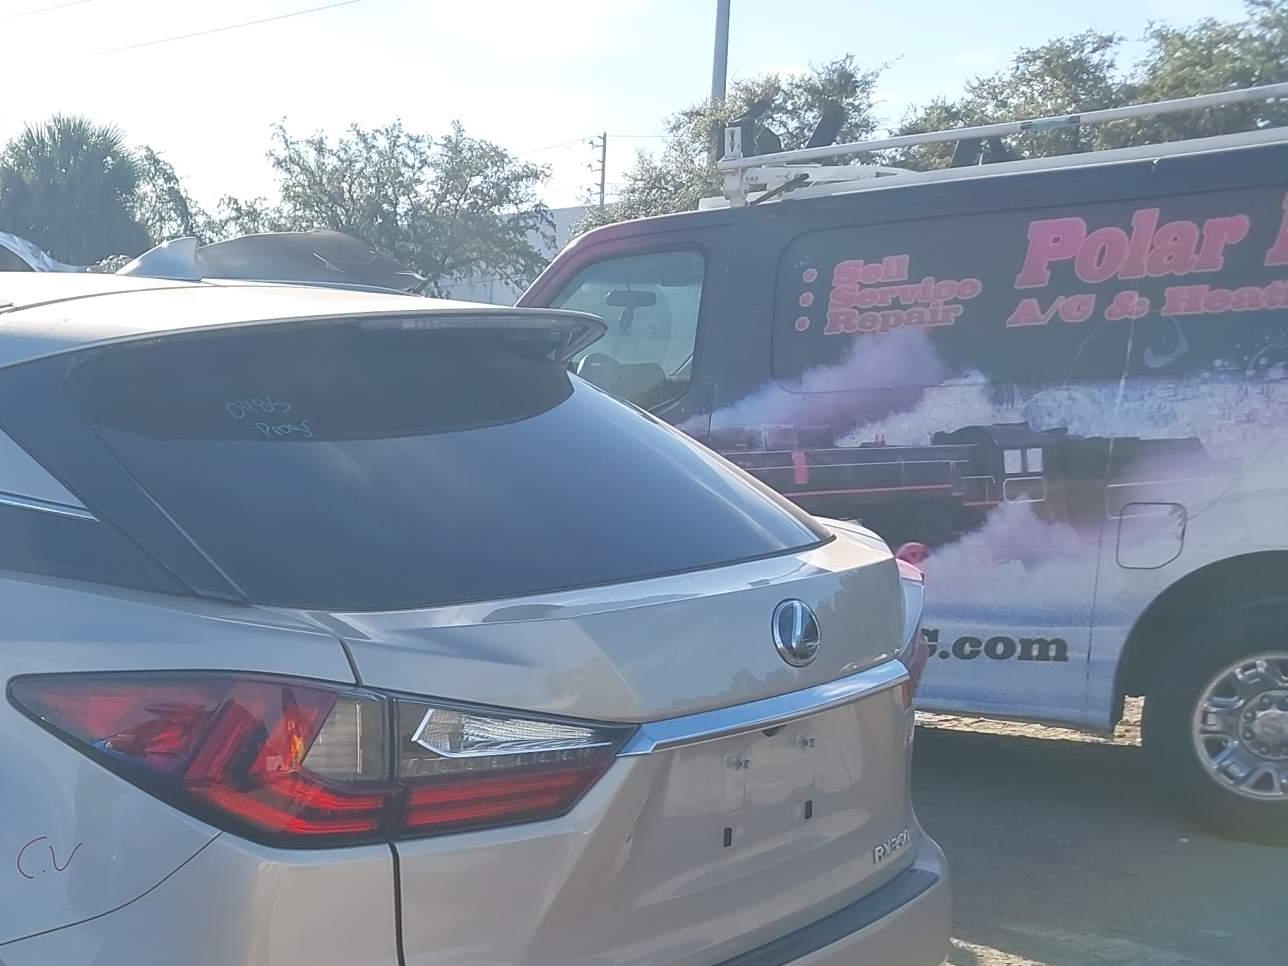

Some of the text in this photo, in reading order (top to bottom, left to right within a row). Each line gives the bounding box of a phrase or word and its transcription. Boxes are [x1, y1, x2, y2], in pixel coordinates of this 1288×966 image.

[1014, 208, 1250, 289] Polar
[833, 254, 910, 287] Sell
[828, 277, 983, 309] Service
[1006, 293, 1097, 327] A/C
[1104, 291, 1151, 321] &
[824, 303, 964, 335] Repair
